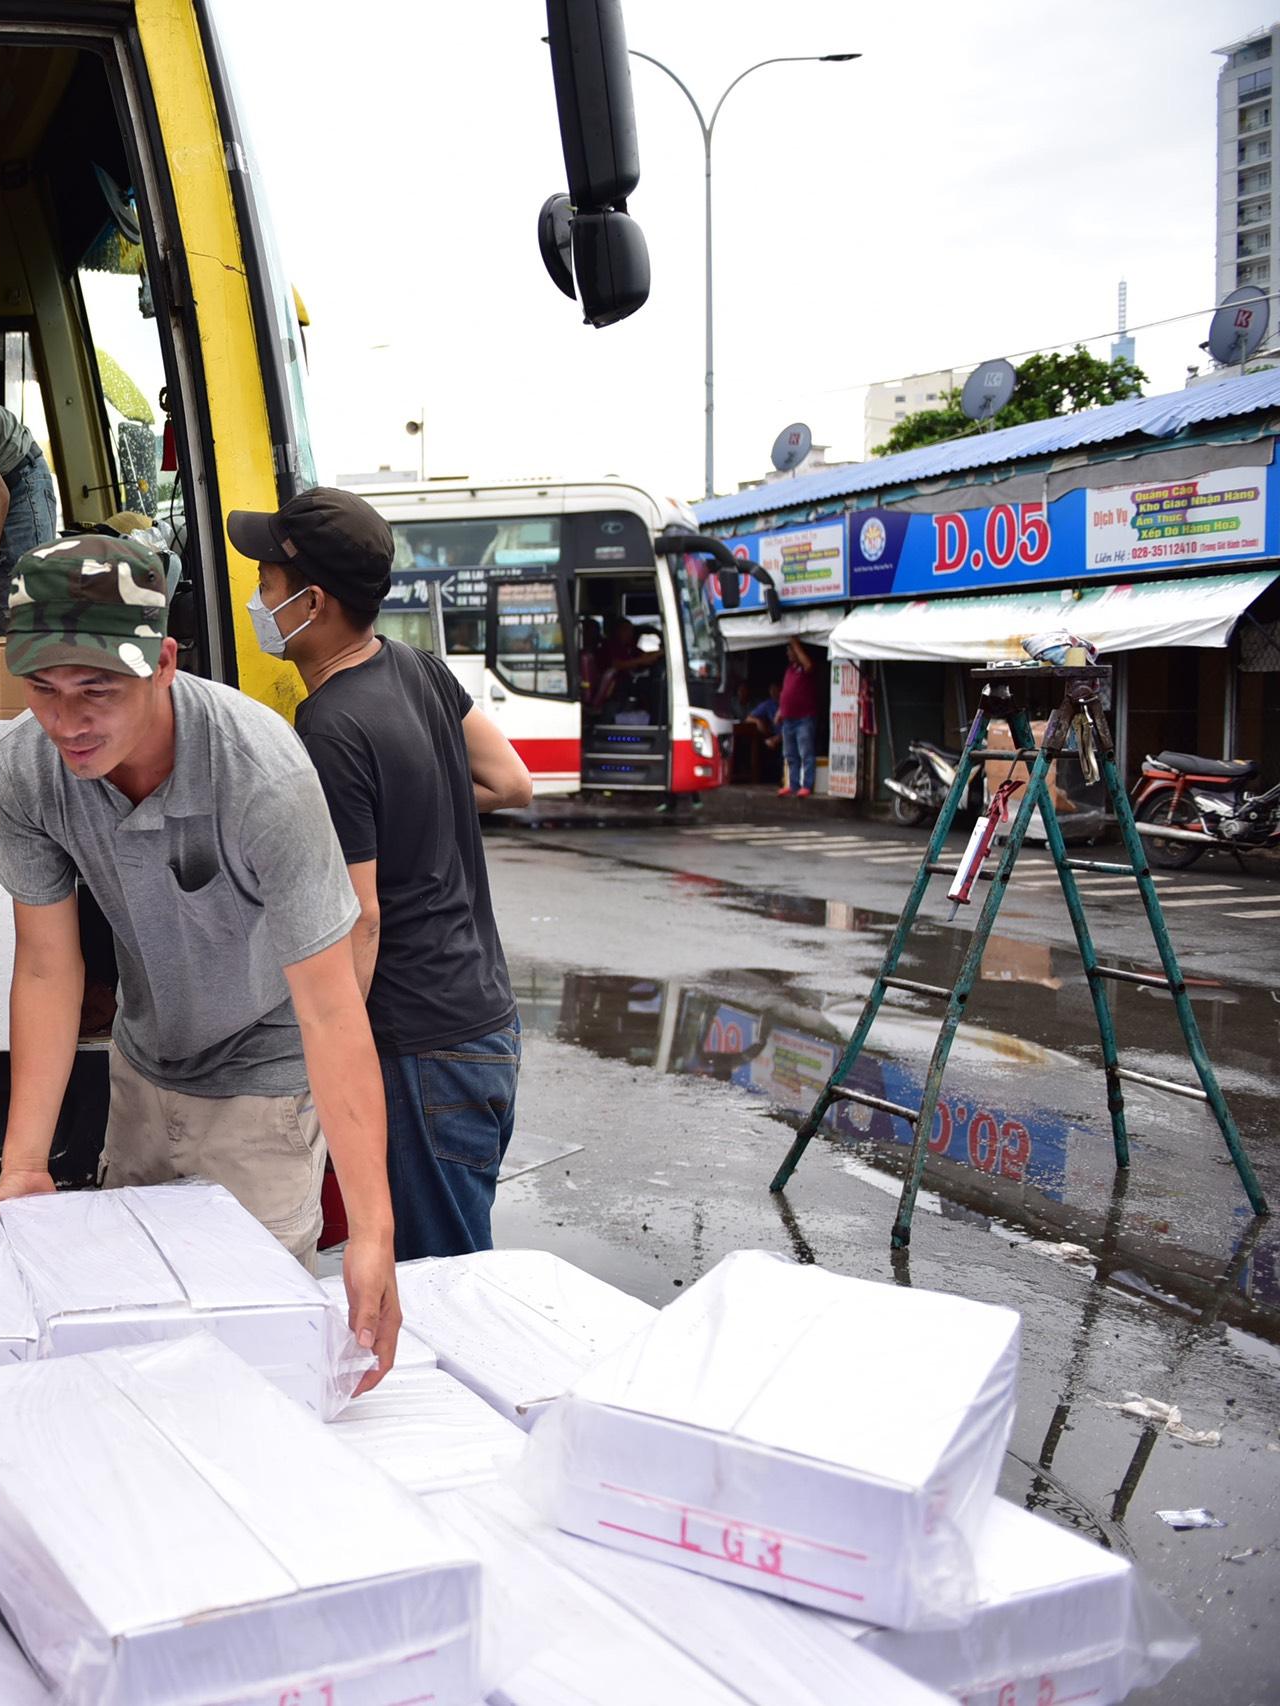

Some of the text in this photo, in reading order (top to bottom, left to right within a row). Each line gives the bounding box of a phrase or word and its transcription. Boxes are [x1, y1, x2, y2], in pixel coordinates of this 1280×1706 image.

[1139, 502, 1160, 513] Kho
[1163, 497, 1188, 509] Giao
[1093, 507, 1128, 530] Dịch Vụ
[932, 503, 1051, 575] D.05
